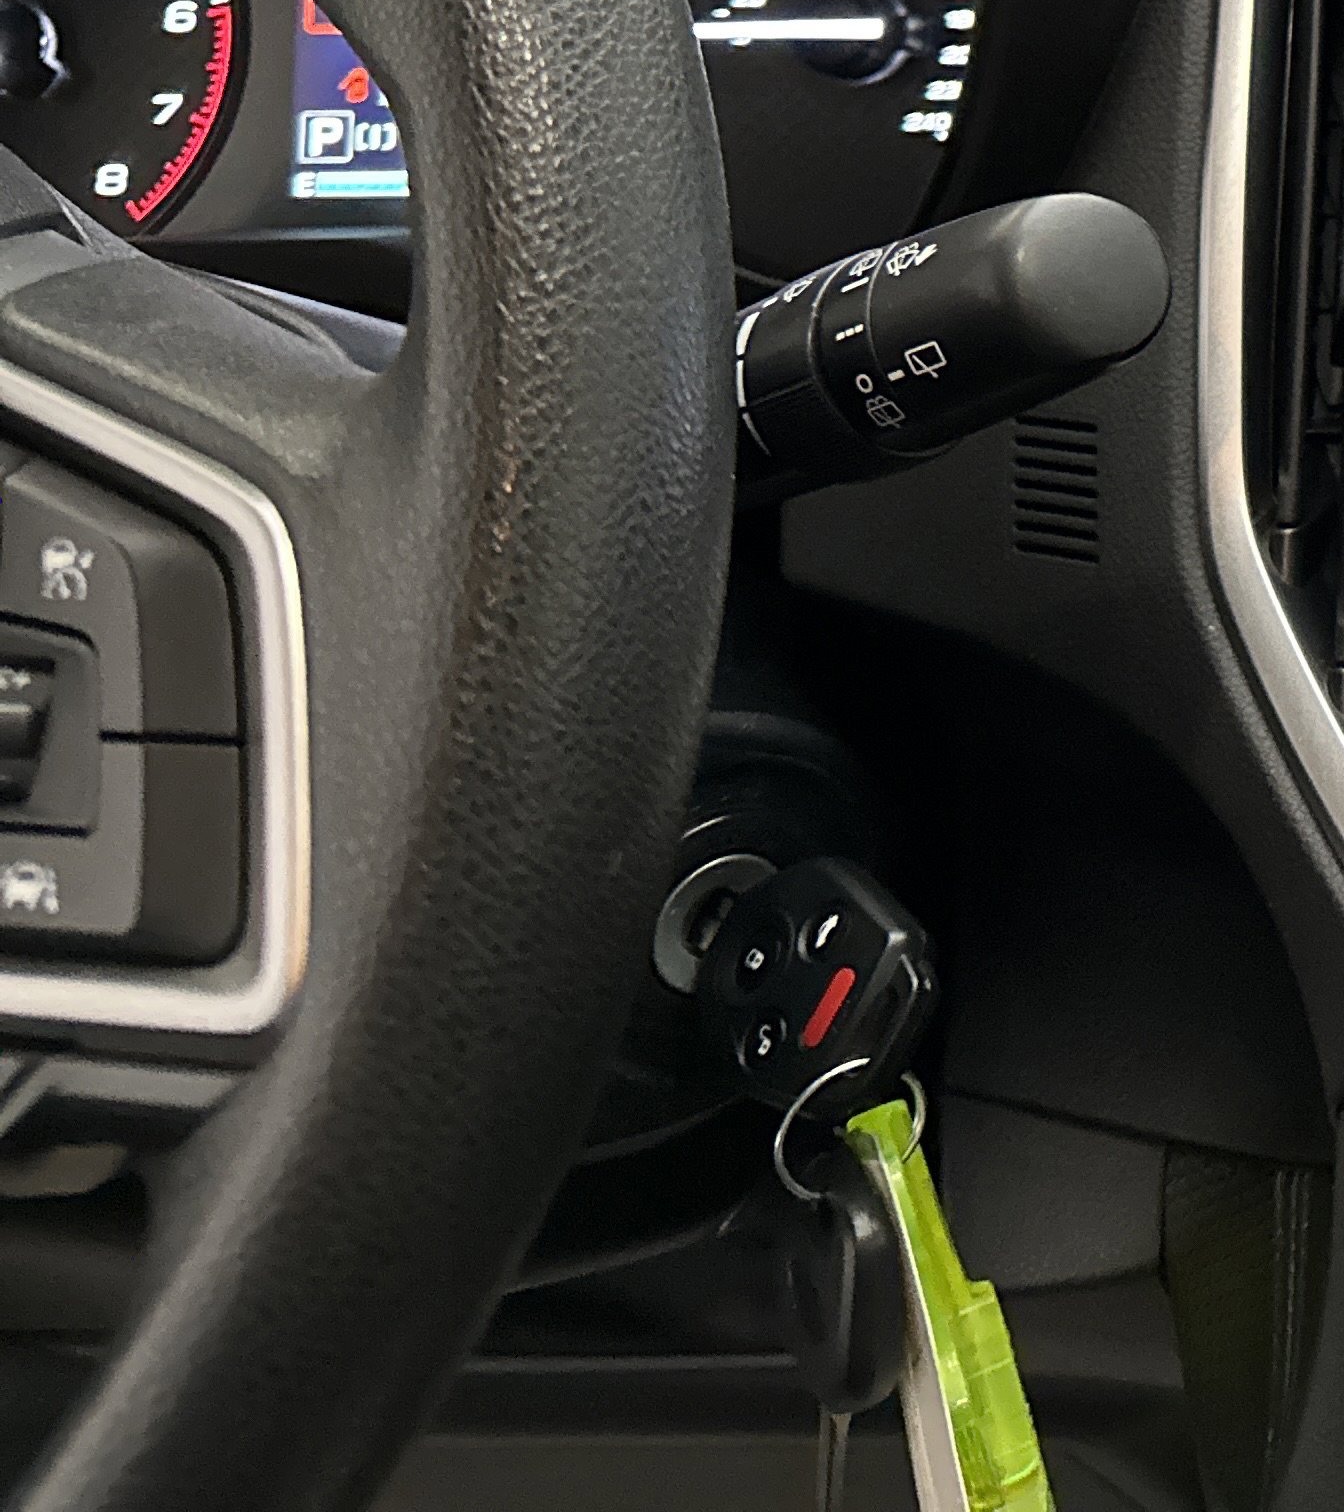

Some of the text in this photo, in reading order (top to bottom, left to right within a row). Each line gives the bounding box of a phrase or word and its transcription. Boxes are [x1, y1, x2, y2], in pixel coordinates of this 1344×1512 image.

[162, 0, 198, 34] 6
[150, 91, 184, 126] 7
[307, 116, 344, 158] P
[93, 161, 130, 198] 8
